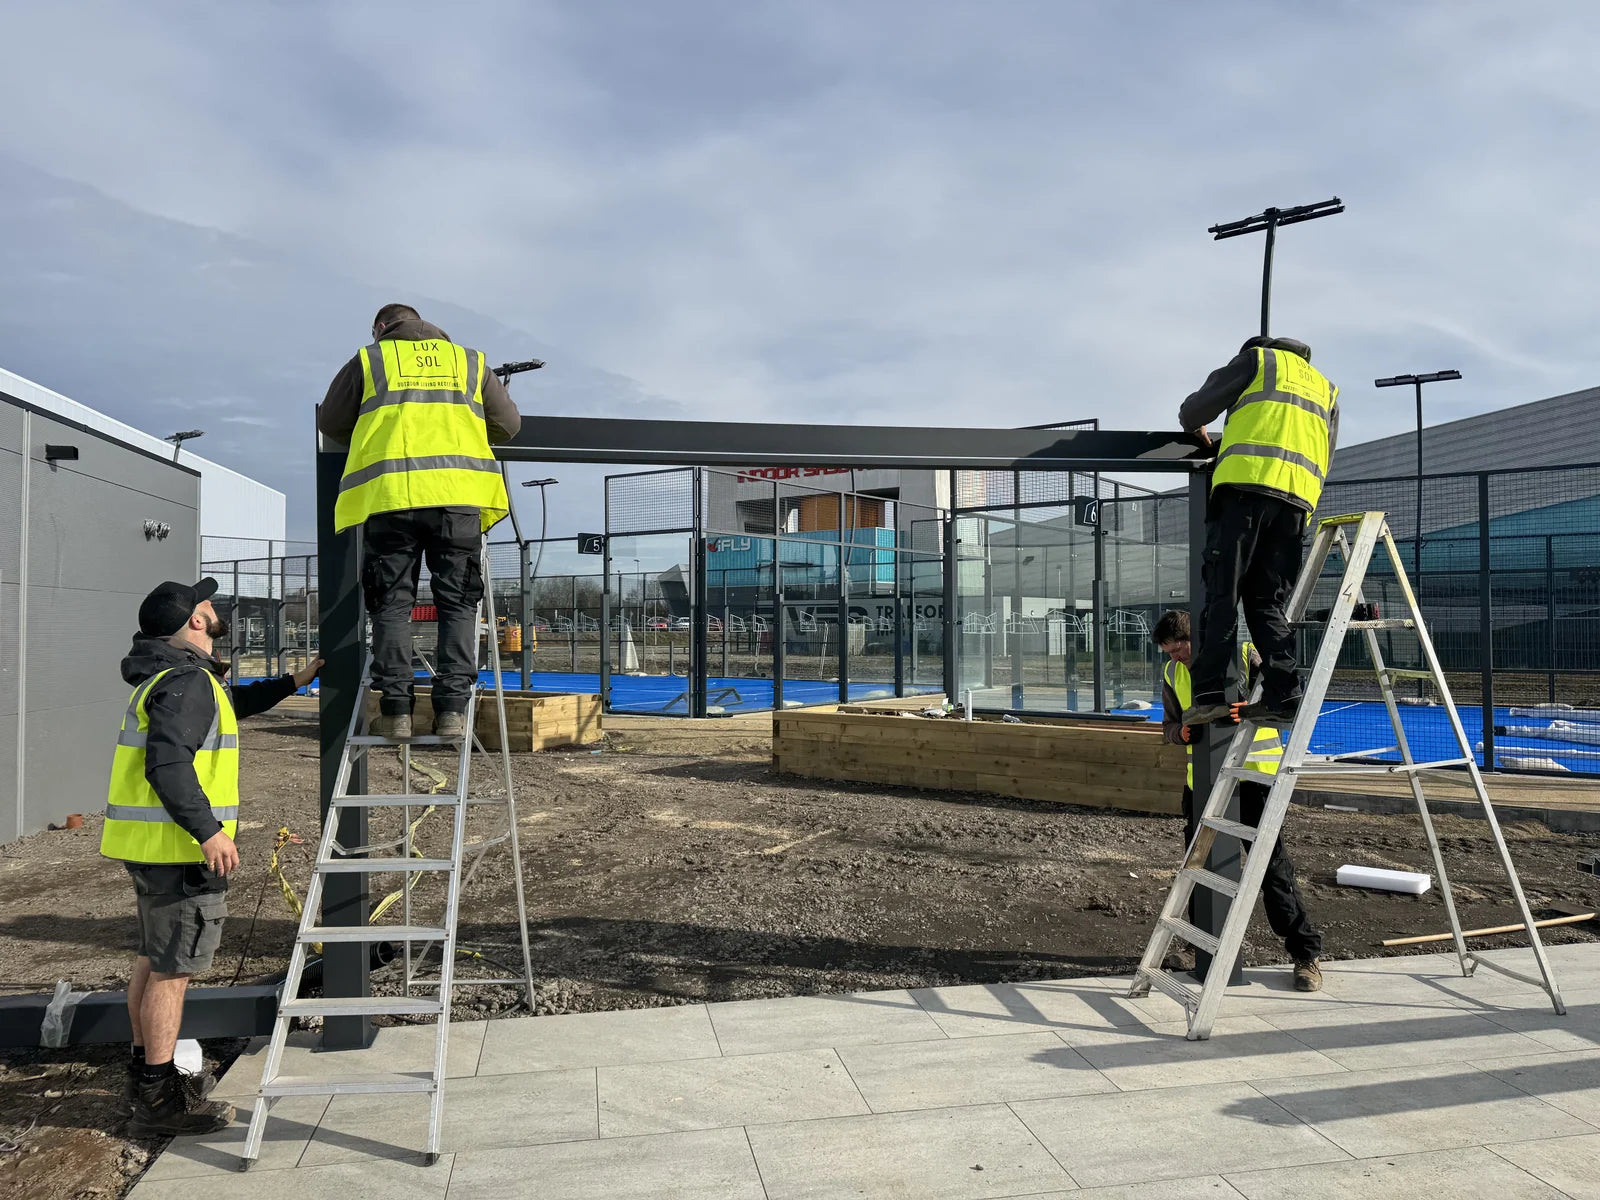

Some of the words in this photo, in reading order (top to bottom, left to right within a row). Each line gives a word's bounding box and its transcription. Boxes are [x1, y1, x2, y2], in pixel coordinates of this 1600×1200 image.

[413, 342, 440, 352] LUX
[415, 355, 442, 368] SOL
[1298, 369, 1316, 384] SOL
[1090, 505, 1098, 522] 6
[593, 539, 600, 552] 5
[1342, 583, 1354, 603] 4
